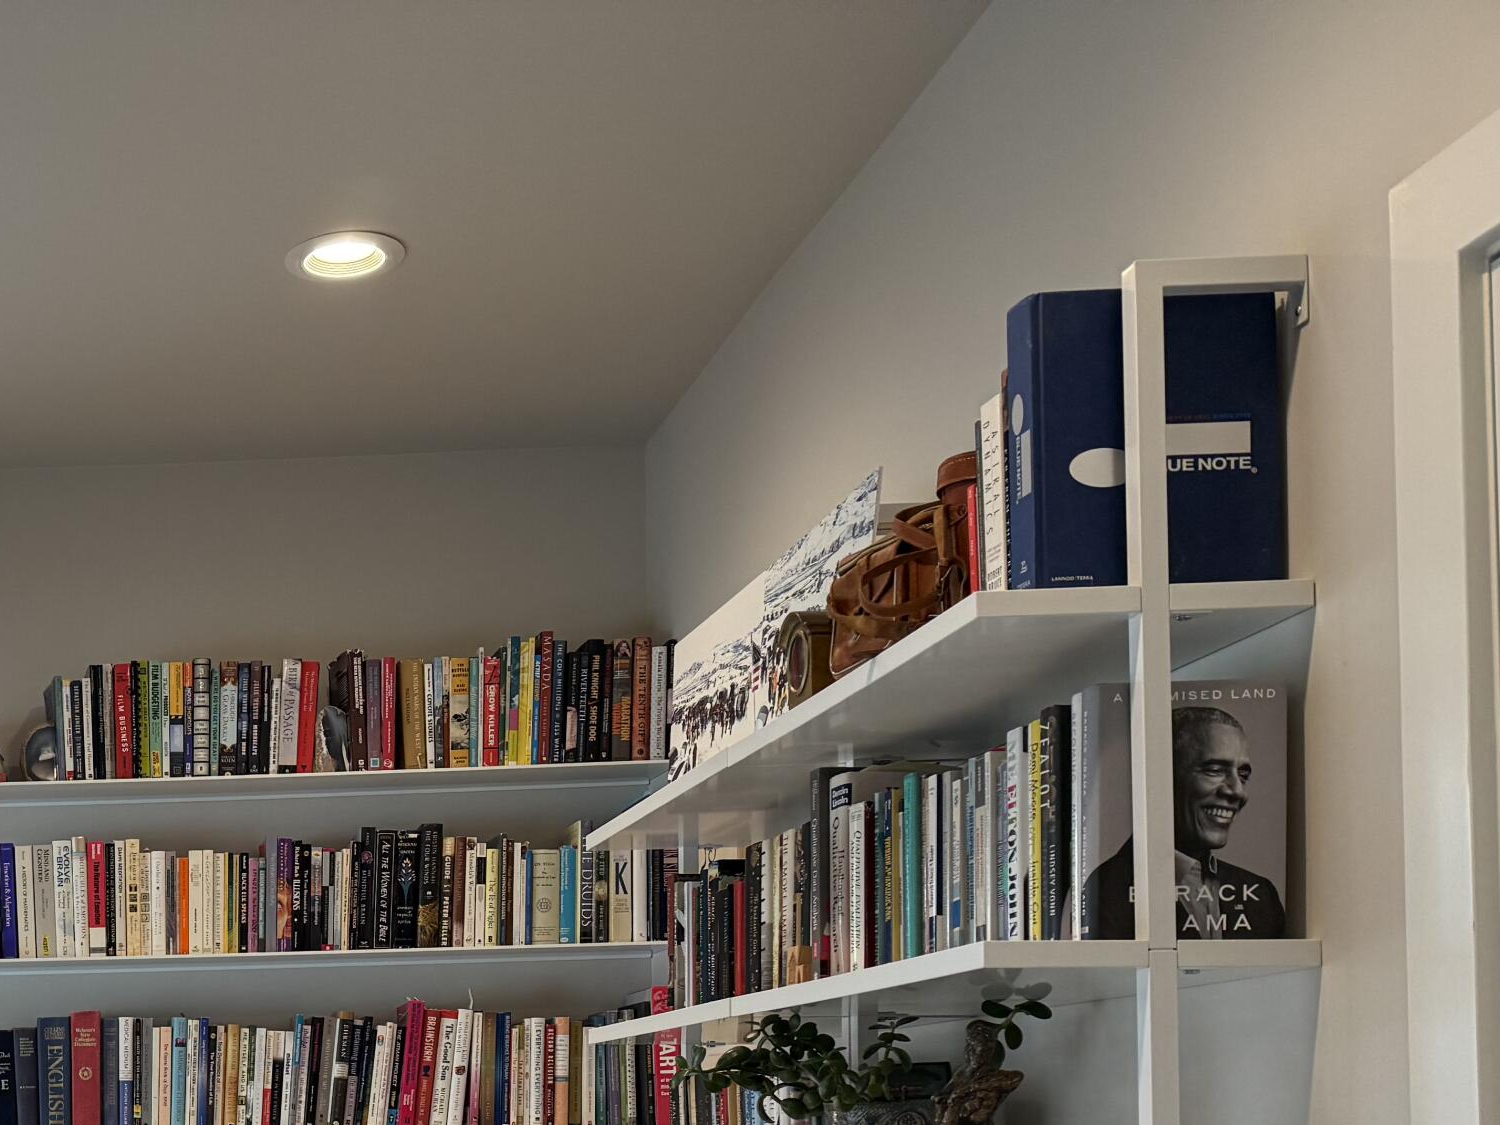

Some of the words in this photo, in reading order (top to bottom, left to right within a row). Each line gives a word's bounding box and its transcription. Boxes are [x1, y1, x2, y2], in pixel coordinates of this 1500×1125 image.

[983, 420, 993, 535] DYNAMICS
[991, 430, 1001, 517] ASTRAL
[1167, 458, 1195, 472] UE
[1198, 456, 1252, 471] NOTE
[541, 635, 552, 690] MASADA
[591, 655, 600, 671] PHIL
[555, 679, 563, 711] MILLIONS
[580, 668, 588, 693] RIVER
[591, 672, 599, 699] KNIGHT
[1113, 693, 1123, 703] A
[1170, 690, 1223, 701] MISED
[1231, 688, 1276, 699] LAND
[579, 694, 587, 721] TEETH
[589, 706, 598, 725] SHOE
[620, 696, 630, 741] MARATHON
[638, 687, 646, 719] TENTH
[119, 717, 128, 752] BUSINESS
[283, 699, 295, 743] PASSAGE
[488, 714, 496, 745] KILLER
[588, 726, 597, 742] DOG
[612, 704, 620, 736] WOMAN
[638, 722, 646, 745] GIFT
[1030, 743, 1039, 775] Demi
[1030, 780, 1038, 820] Moore
[1007, 784, 1017, 863] ELTON
[382, 841, 390, 854] ALL
[831, 816, 840, 892] Qualitative
[854, 830, 862, 889] QUALITATIVE
[1048, 844, 1056, 885] LINDSEY
[380, 871, 390, 898] WOMEN
[582, 870, 593, 927] DRUIDS
[1129, 884, 1260, 903] RACK
[380, 900, 387, 908] OF
[1008, 868, 1018, 937] JOHN
[379, 924, 387, 942] BIBLE
[831, 896, 839, 953] Research
[1182, 913, 1252, 932] AMA
[351, 1029, 361, 1060] reclaiming
[423, 1016, 437, 1062] BRAINSTORM
[444, 1024, 454, 1040] The
[442, 1042, 452, 1064] Good
[48, 1045, 65, 1125] ENGLISH
[440, 1065, 450, 1081] Son
